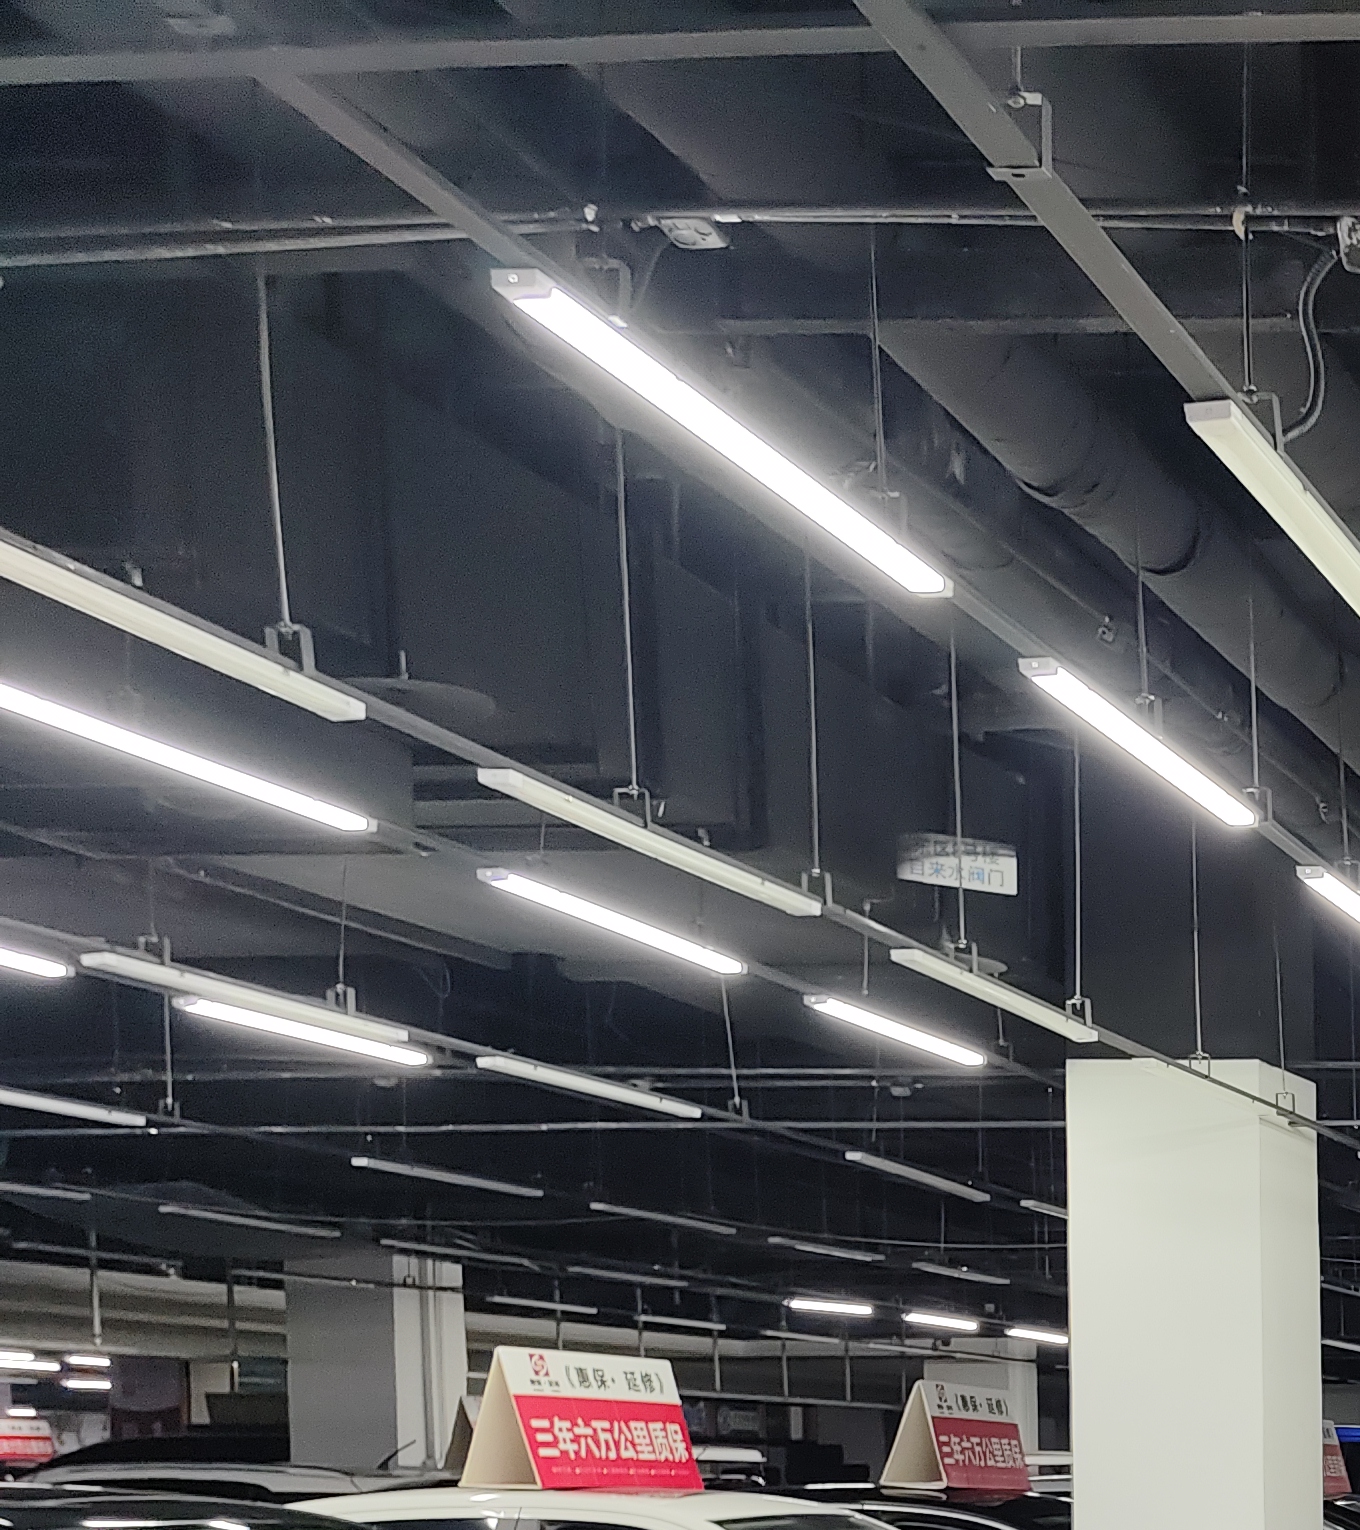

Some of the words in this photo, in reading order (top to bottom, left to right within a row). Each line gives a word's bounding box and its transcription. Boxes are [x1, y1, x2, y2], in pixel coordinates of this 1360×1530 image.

[529, 1416, 690, 1463] 三年六万公里质保
